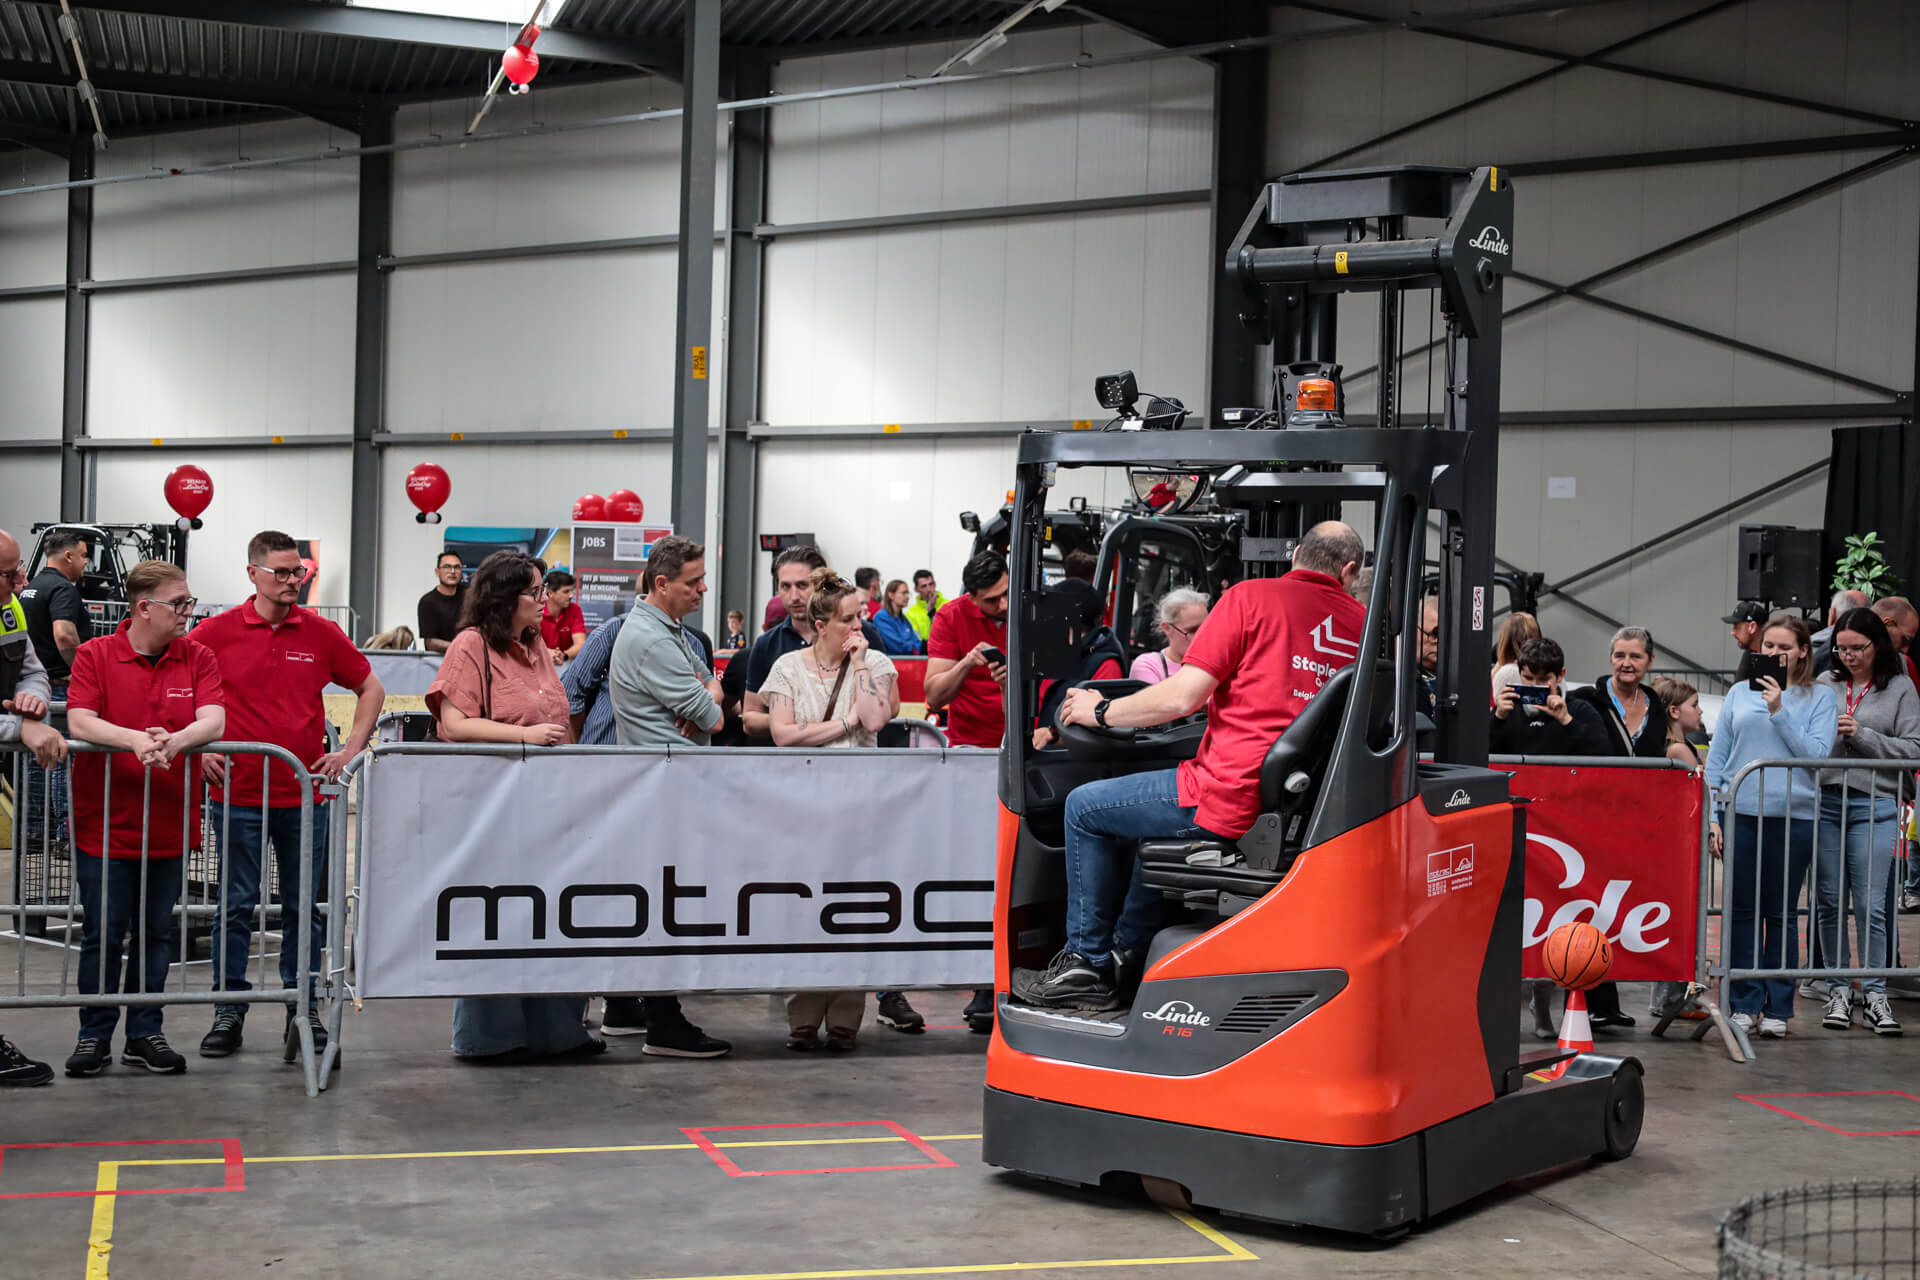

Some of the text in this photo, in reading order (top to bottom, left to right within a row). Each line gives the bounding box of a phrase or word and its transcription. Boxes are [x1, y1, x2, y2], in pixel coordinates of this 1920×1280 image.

[1469, 226, 1509, 255] Linde
[582, 537, 606, 549] JOBS
[1292, 655, 1337, 678] Staple
[1445, 789, 1470, 808] Linde
[1142, 1000, 1211, 1026] Linde
